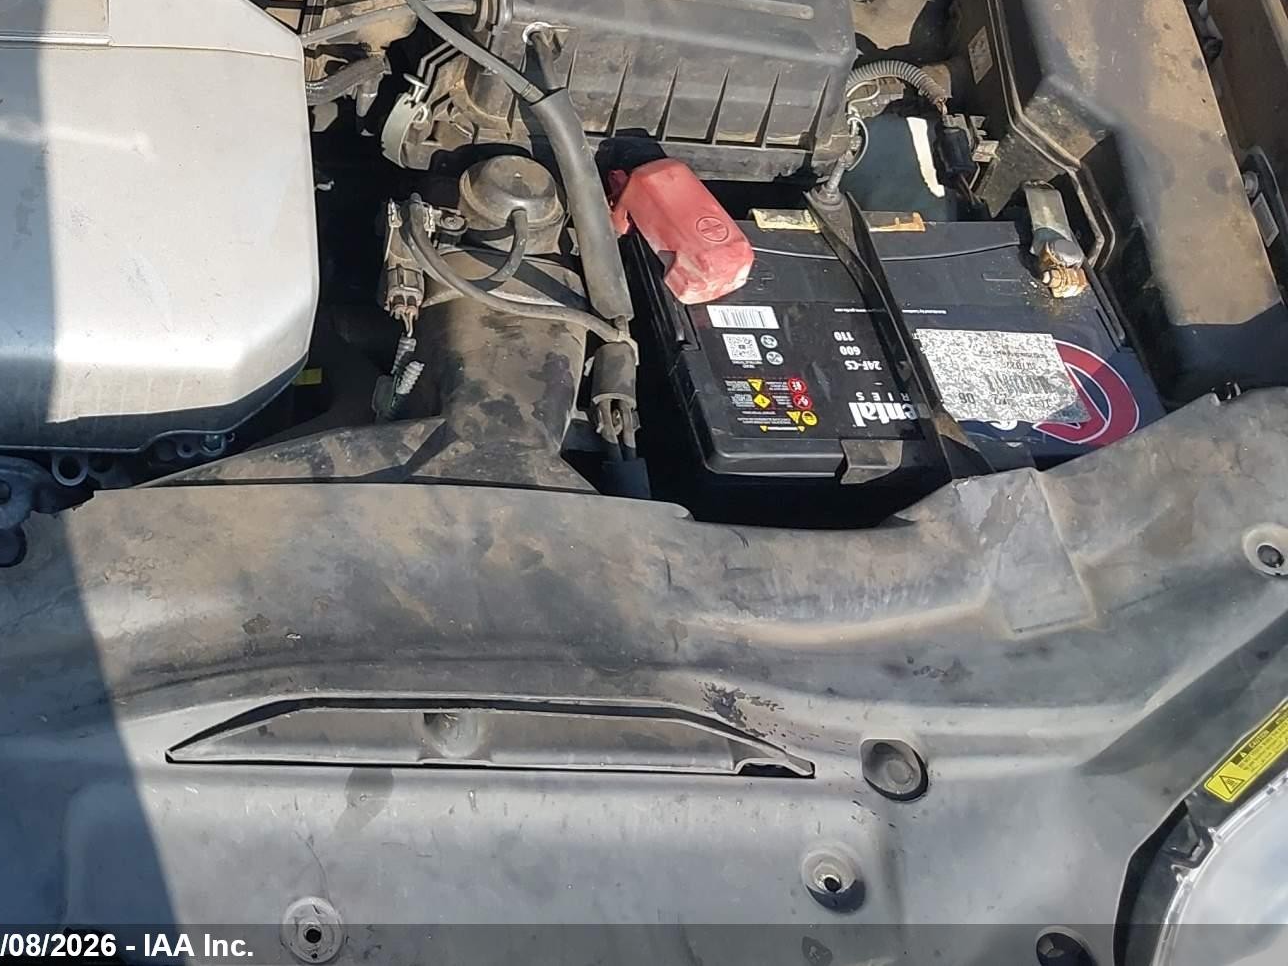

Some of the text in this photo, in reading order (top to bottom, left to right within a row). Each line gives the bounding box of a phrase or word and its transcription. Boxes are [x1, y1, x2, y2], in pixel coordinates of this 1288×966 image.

[833, 331, 855, 342] 110
[839, 345, 861, 356] 600
[844, 360, 883, 371] 24F-CS
